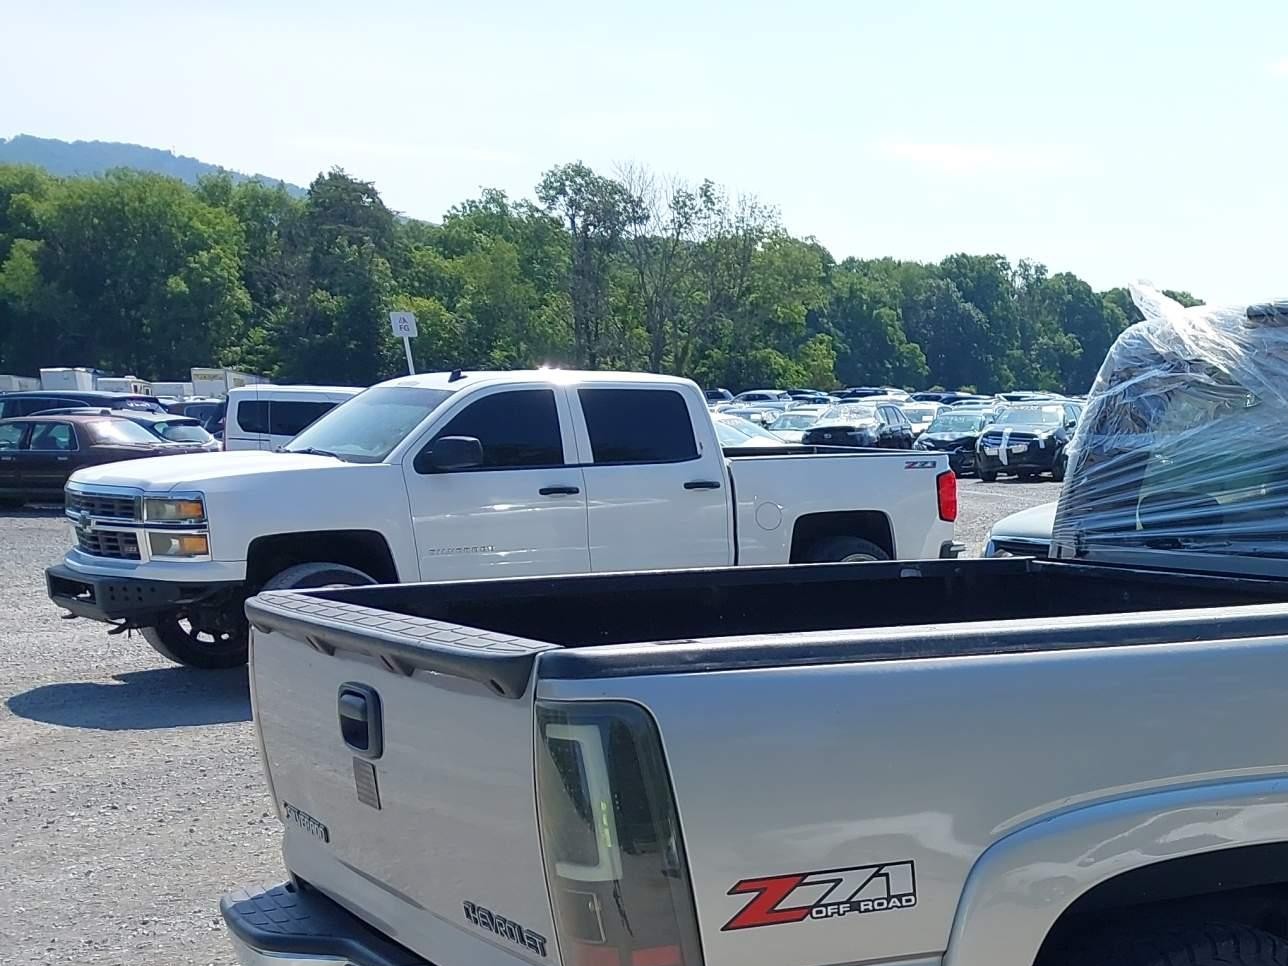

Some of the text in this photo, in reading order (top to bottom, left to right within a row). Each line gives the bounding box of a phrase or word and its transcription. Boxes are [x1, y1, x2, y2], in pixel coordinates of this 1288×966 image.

[719, 860, 916, 932] Z71
[811, 895, 916, 919] OFF ROAD
